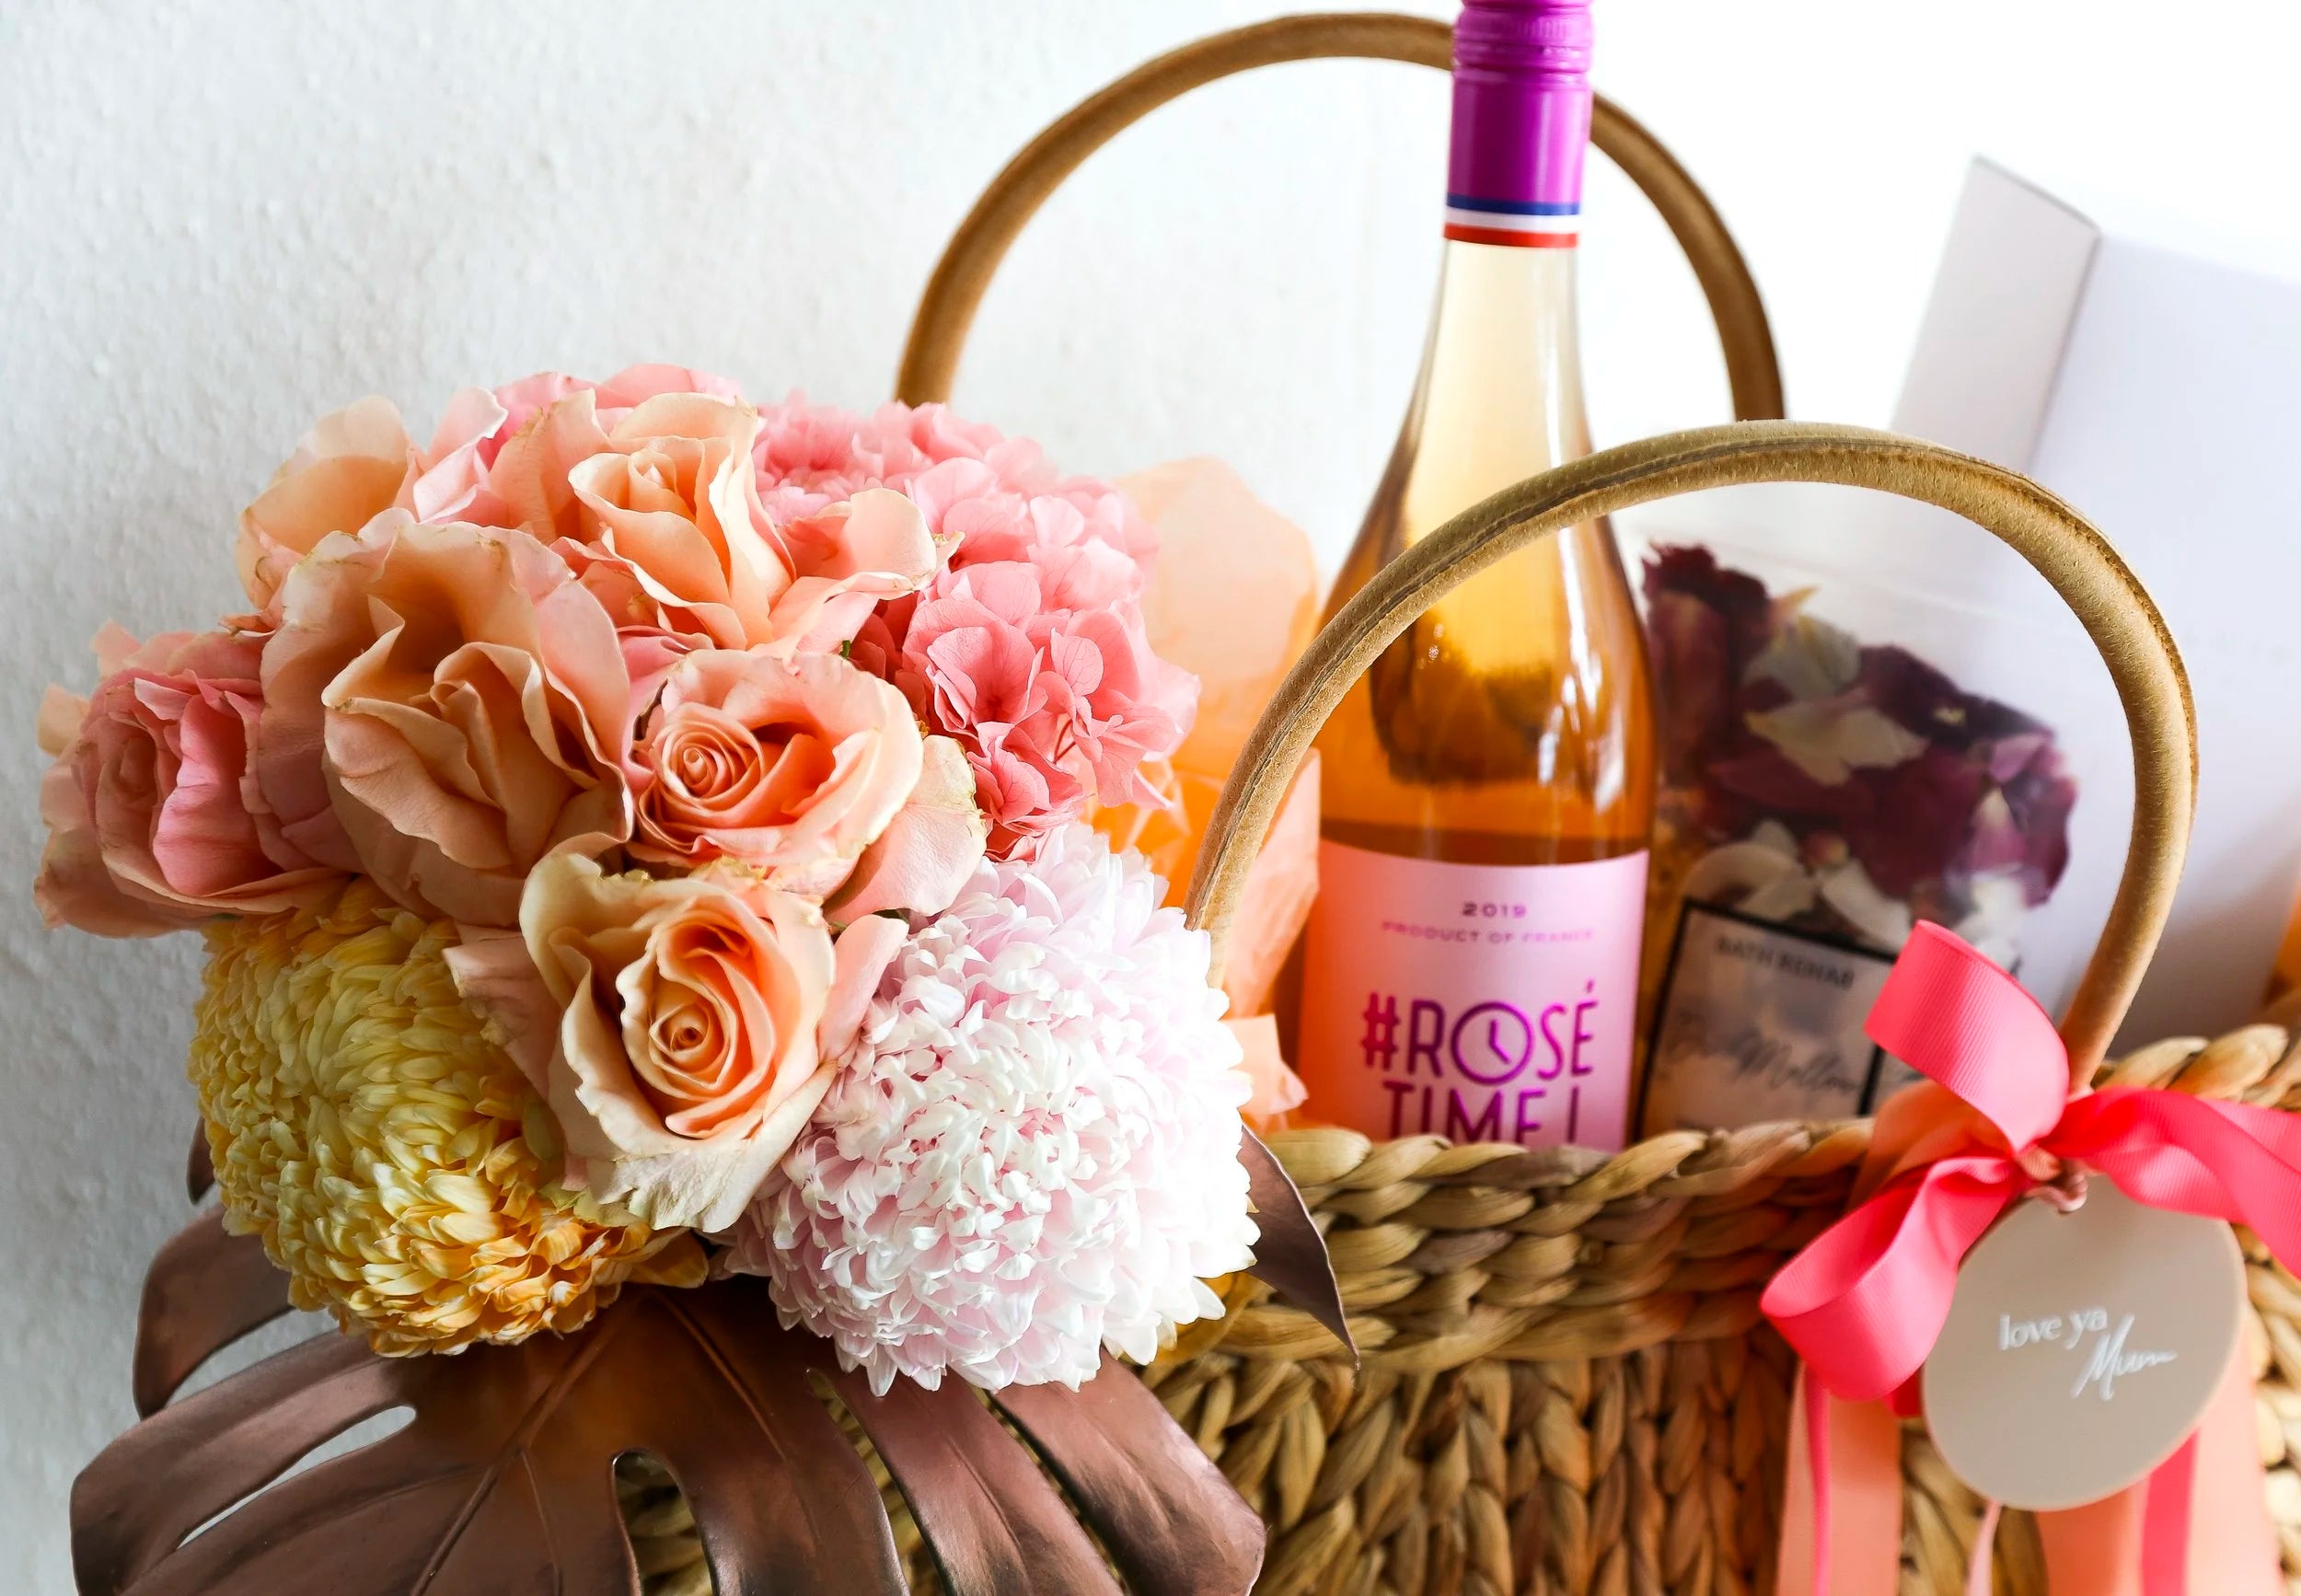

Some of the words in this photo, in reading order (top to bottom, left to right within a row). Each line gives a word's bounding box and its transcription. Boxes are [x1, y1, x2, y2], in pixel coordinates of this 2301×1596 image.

[1462, 901, 1528, 919] 2019
[1382, 920, 1480, 943] PRODUCT
[1488, 930, 1515, 944] OF
[1998, 1312, 2063, 1351] love
[2066, 1305, 2109, 1350] ya
